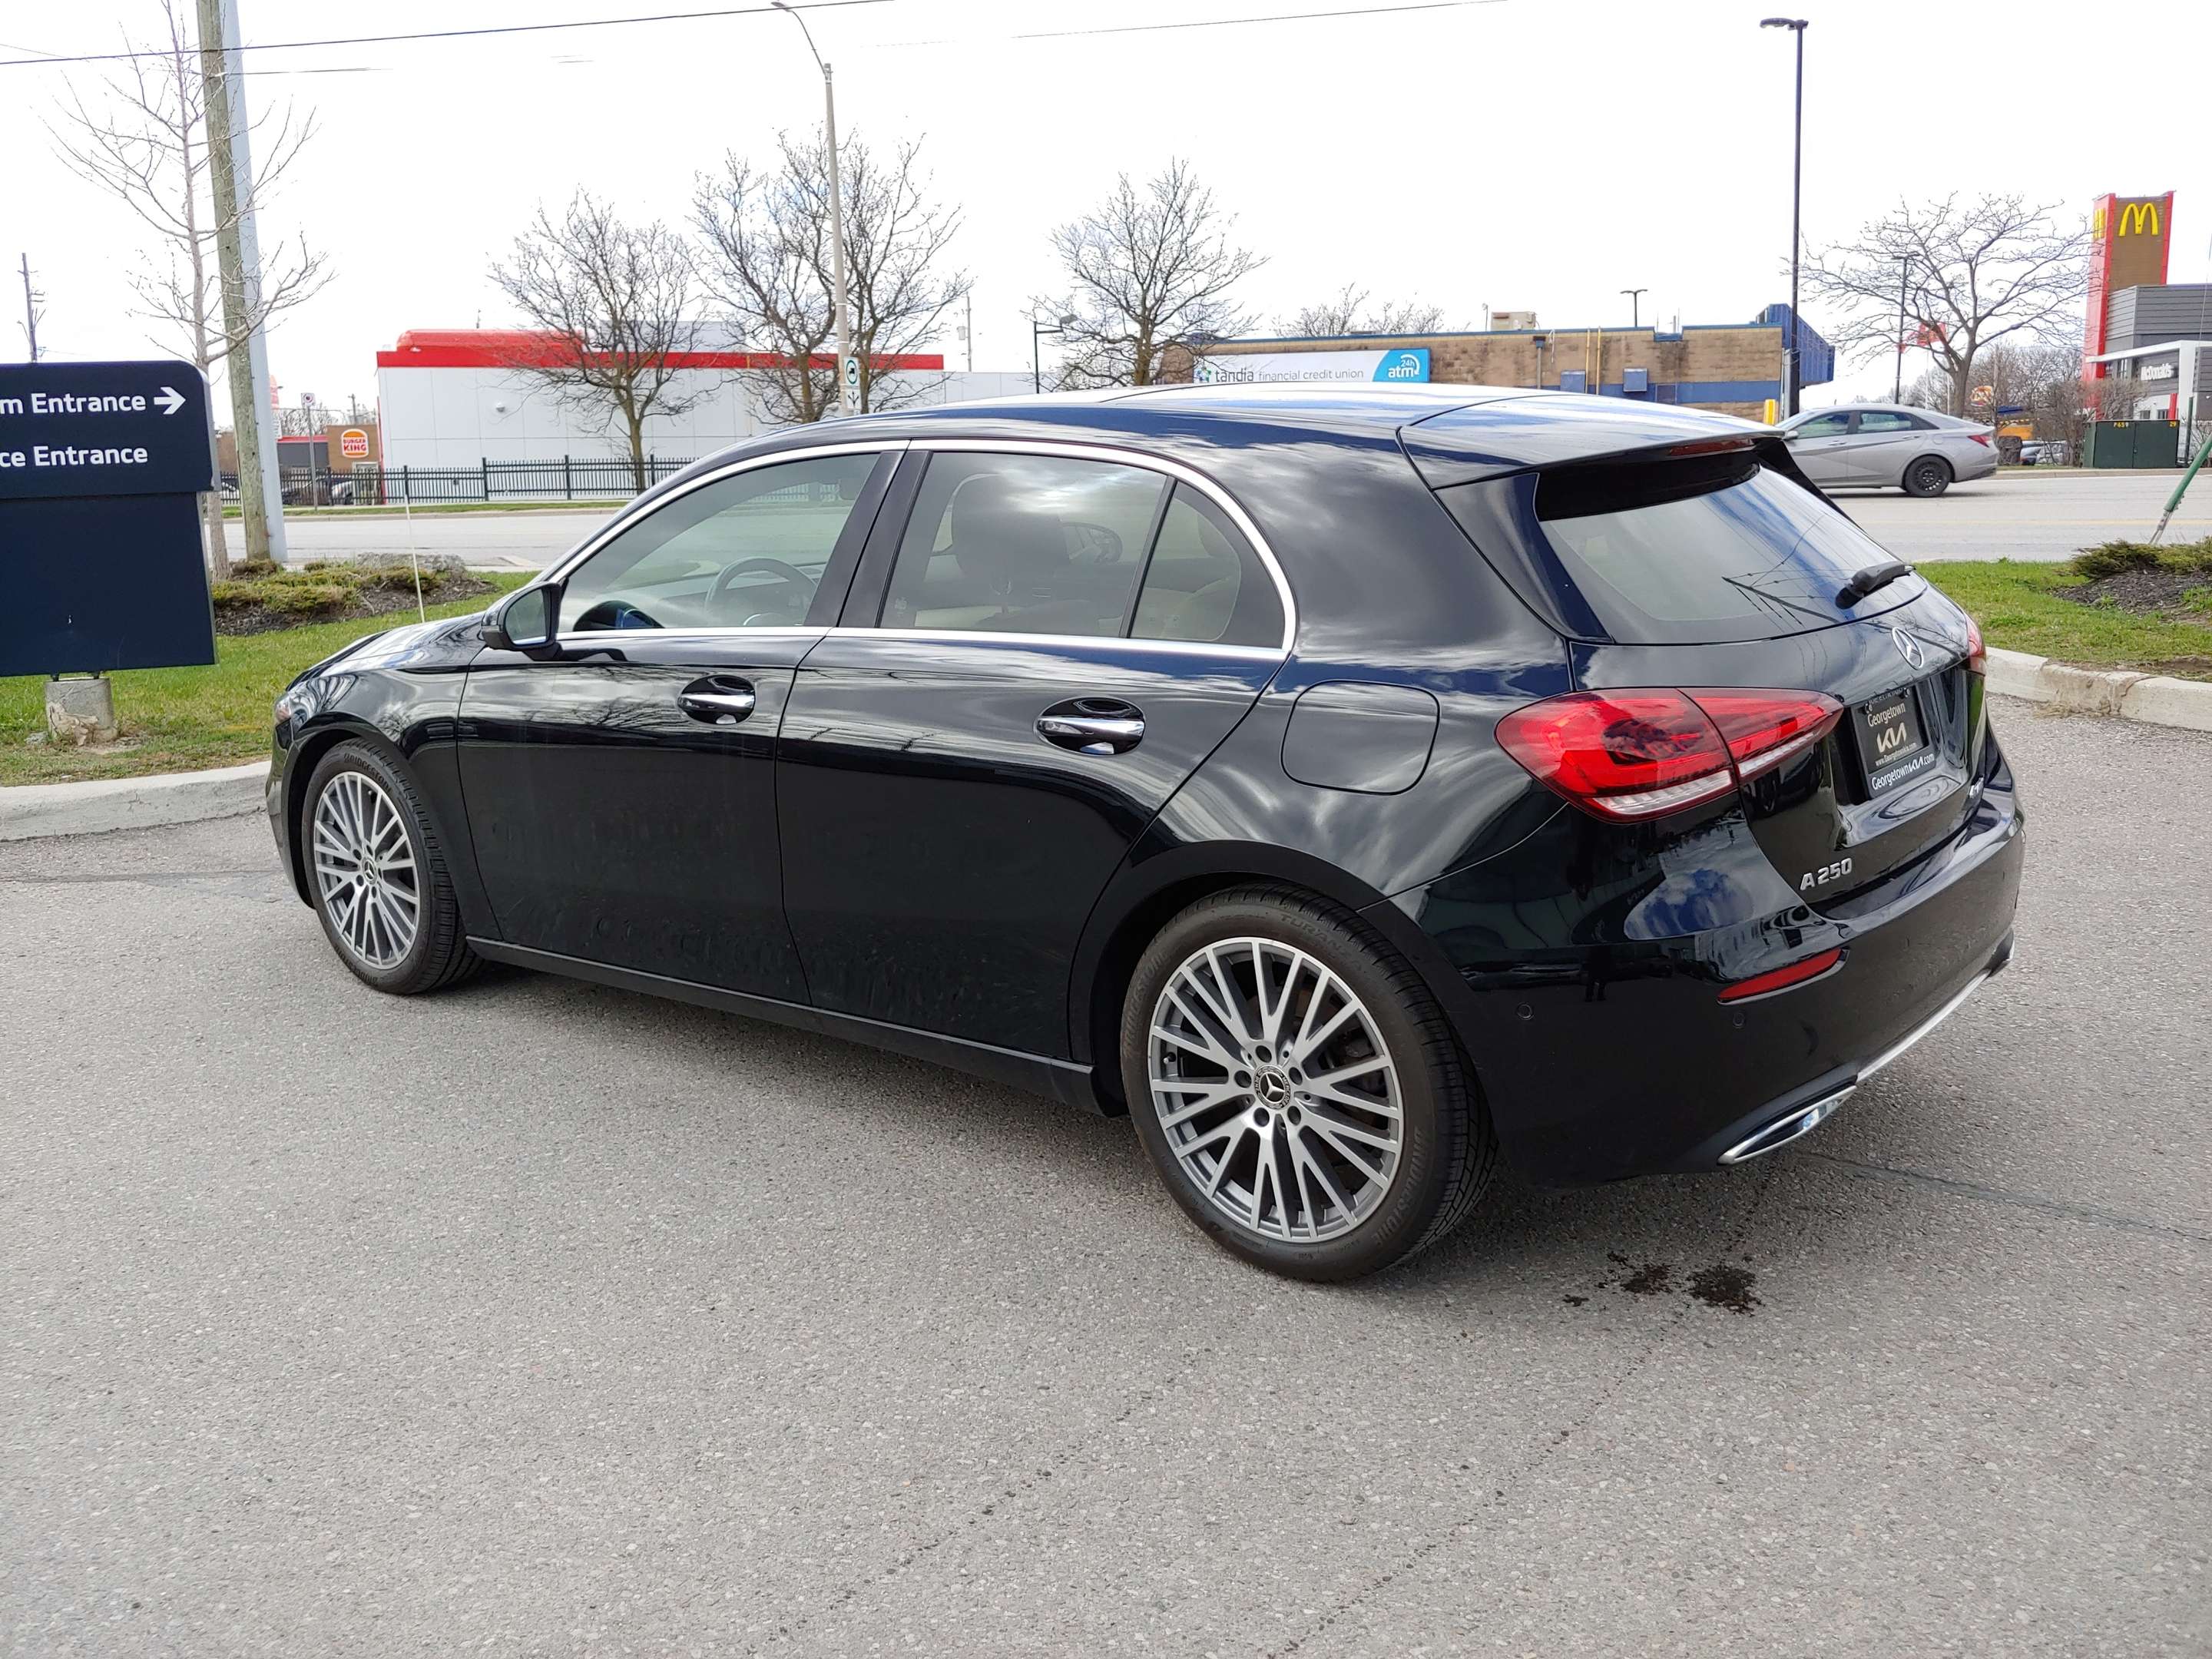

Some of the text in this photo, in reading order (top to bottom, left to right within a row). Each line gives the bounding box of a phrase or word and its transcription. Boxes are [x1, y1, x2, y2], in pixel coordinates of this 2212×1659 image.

[1216, 368, 1364, 382] tandia financial credit union
[1389, 366, 1414, 378] atm
[31, 392, 146, 414] Entrance
[33, 445, 148, 466] Entrance
[1867, 703, 1906, 727] Georgetown
[1800, 857, 1853, 891] A 250
